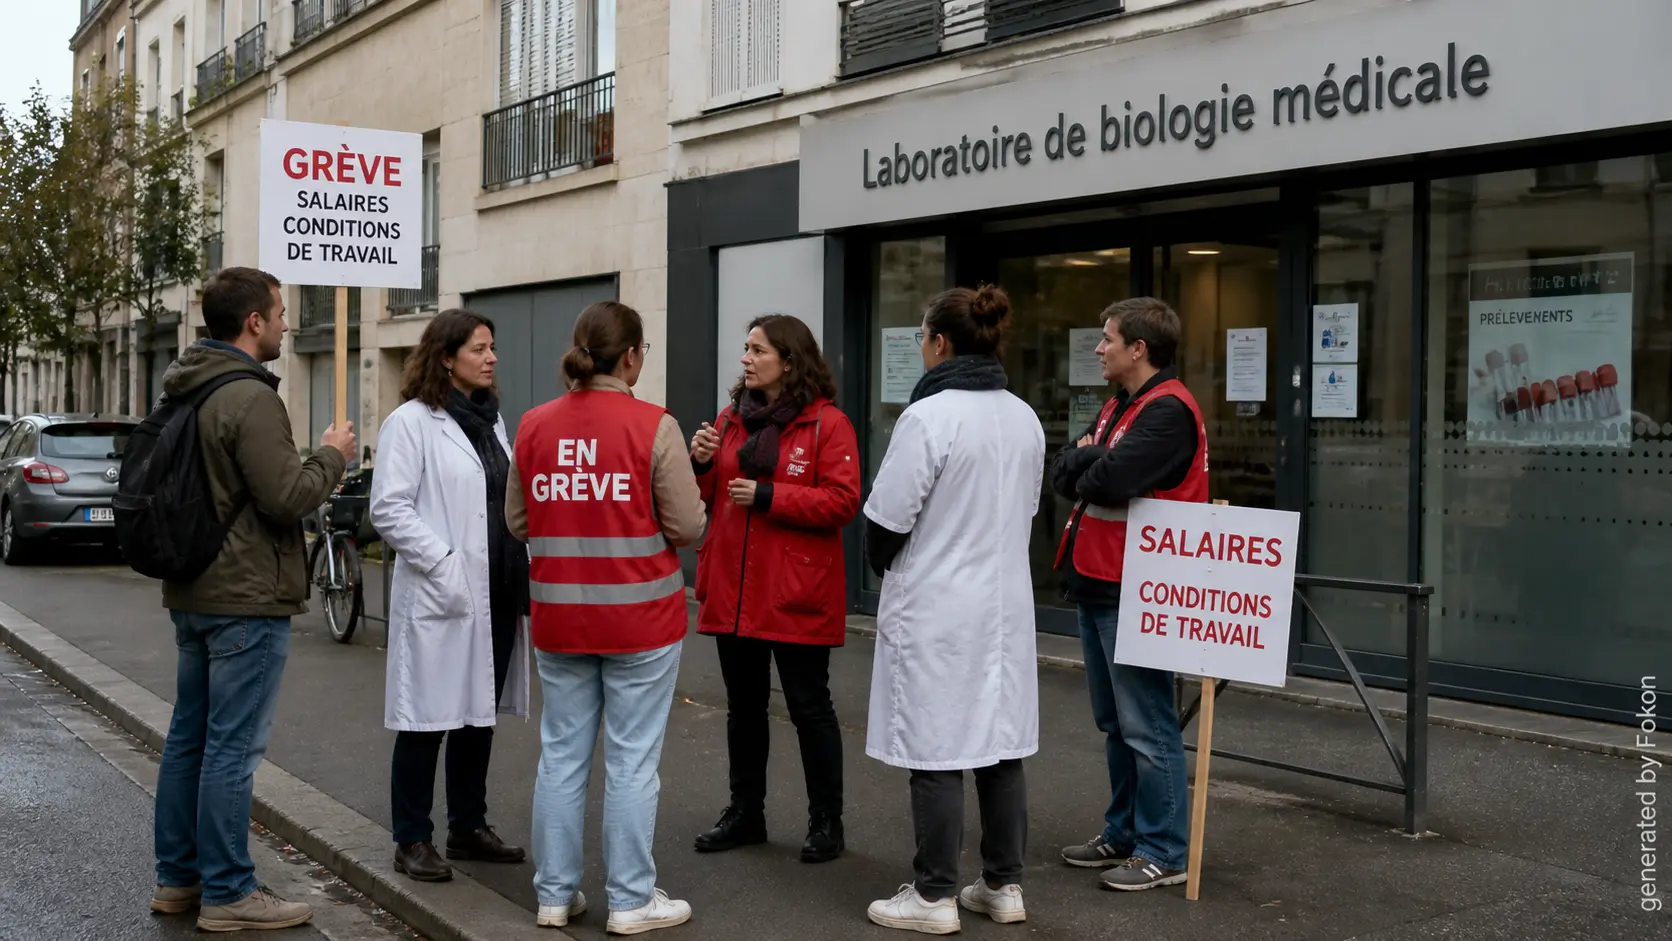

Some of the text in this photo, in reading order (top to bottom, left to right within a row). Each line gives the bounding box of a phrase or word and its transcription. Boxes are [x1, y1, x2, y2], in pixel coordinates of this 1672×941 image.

[863, 41, 1491, 188] Laboratoire de biologie médicale
[283, 143, 402, 187] GRÈVE
[297, 190, 389, 213] SALAIRES
[283, 216, 401, 239] CONDITIONS
[287, 242, 398, 265] DE TRAVAIL
[557, 438, 598, 466] EN
[531, 466, 631, 502] GRÈVE
[1138, 524, 1283, 568] SALAIRES
[1139, 580, 1272, 619] CONDITIONS
[1140, 611, 1265, 650] DE TRAVAIL
